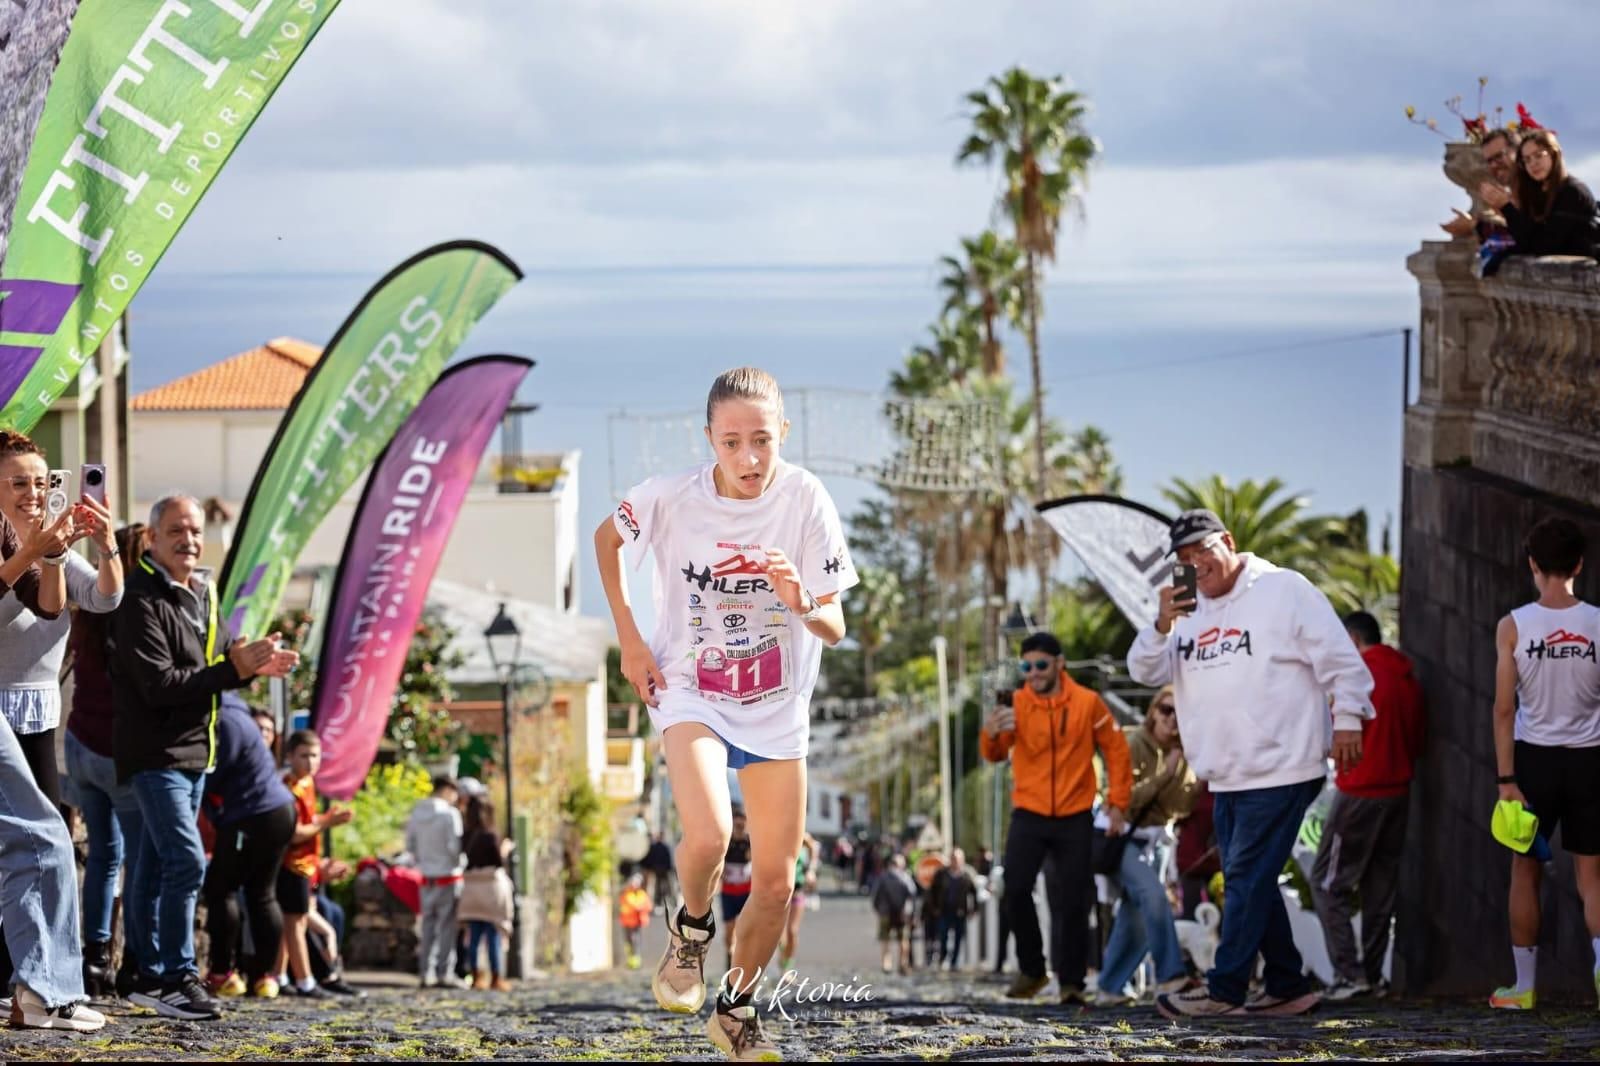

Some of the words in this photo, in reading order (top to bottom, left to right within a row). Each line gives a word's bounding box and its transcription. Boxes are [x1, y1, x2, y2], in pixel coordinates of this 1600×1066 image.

[38, 248, 145, 408] EVENTOS
[155, 0, 318, 221] DEPORTIVOS
[384, 546, 422, 619] PALMA
[681, 559, 775, 595] HILER
[321, 543, 403, 759] MOUNTAIN
[382, 436, 448, 536] RIDE
[716, 601, 755, 611] deporte
[725, 627, 748, 636] TOYOTA
[1525, 638, 1597, 665] HILERA
[724, 659, 761, 691] 11
